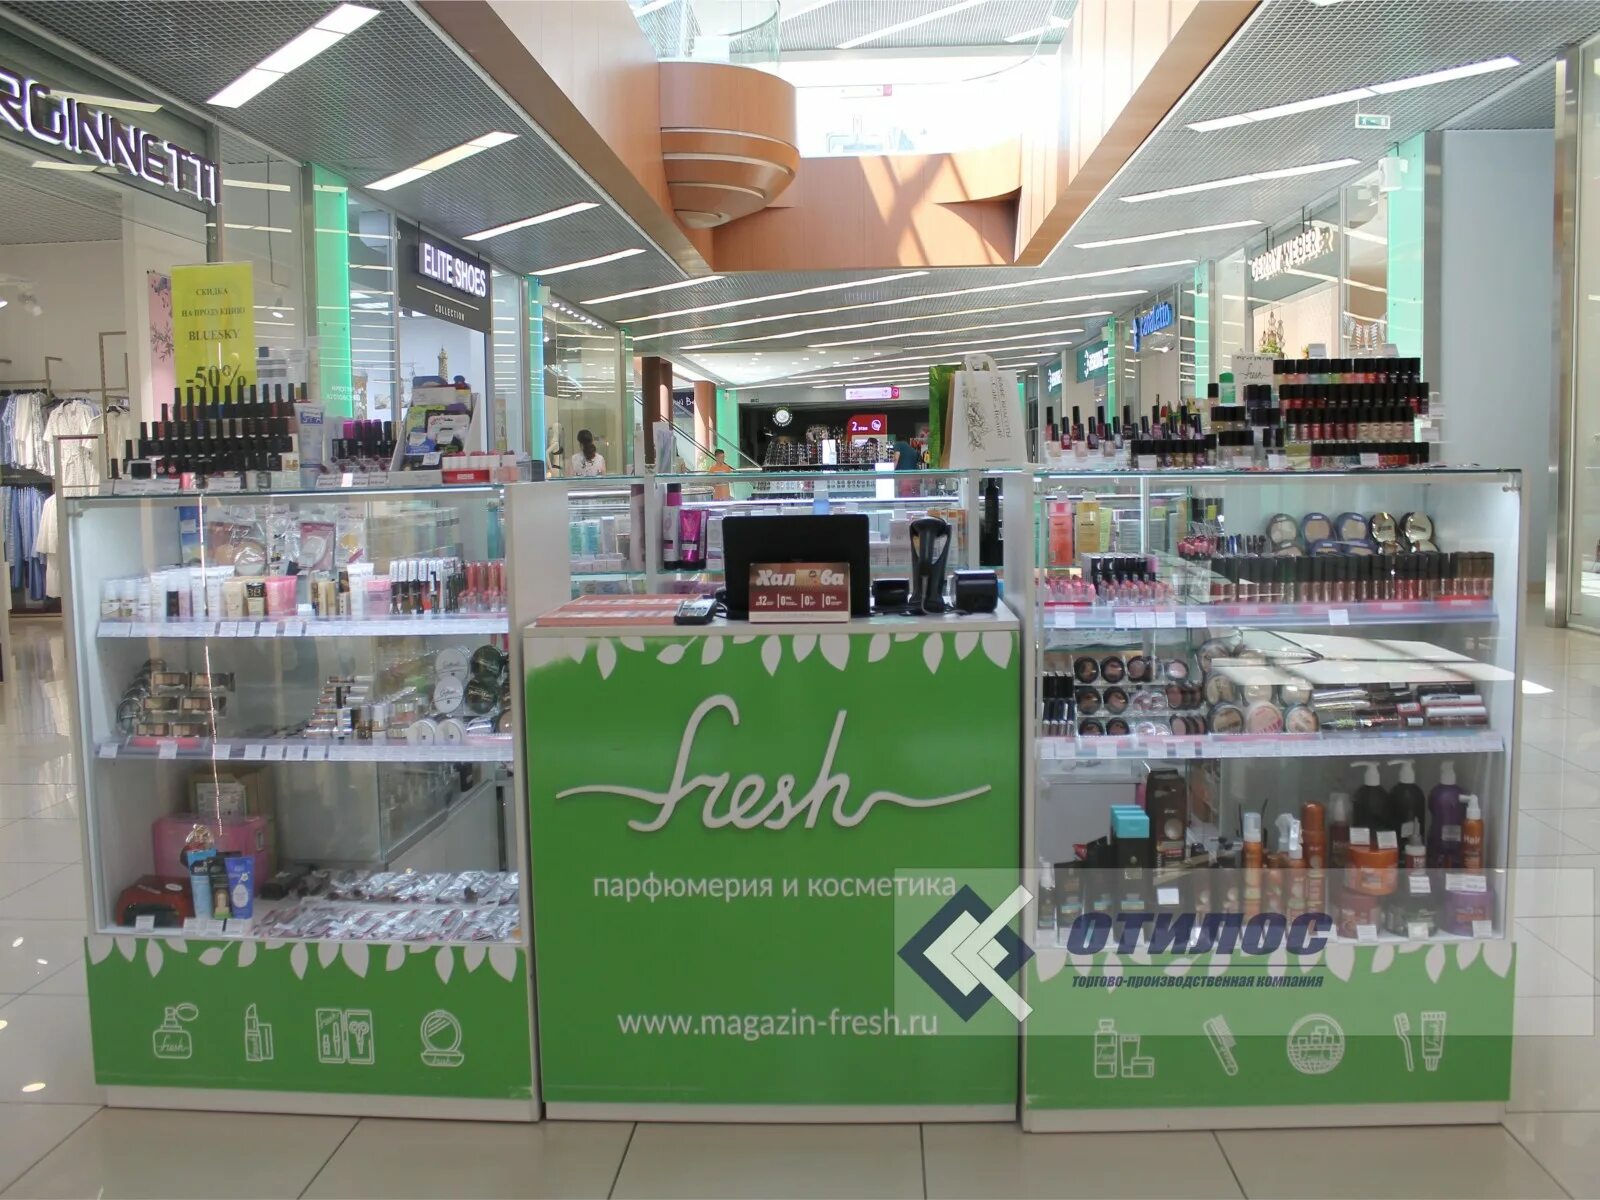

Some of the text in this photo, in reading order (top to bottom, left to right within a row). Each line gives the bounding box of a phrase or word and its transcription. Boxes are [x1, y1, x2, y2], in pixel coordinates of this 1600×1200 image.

[424, 242, 486, 297] ELITE SHOES
[195, 287, 229, 296] СКИДКА
[434, 303, 465, 321] COLLECTION
[188, 328, 240, 341] BLUESKY
[185, 364, 247, 389] -50%
[556, 694, 992, 832] fresh
[593, 871, 957, 902] парфюмерия и косметика
[617, 1008, 938, 1041] www.magazin-fresh.ru
